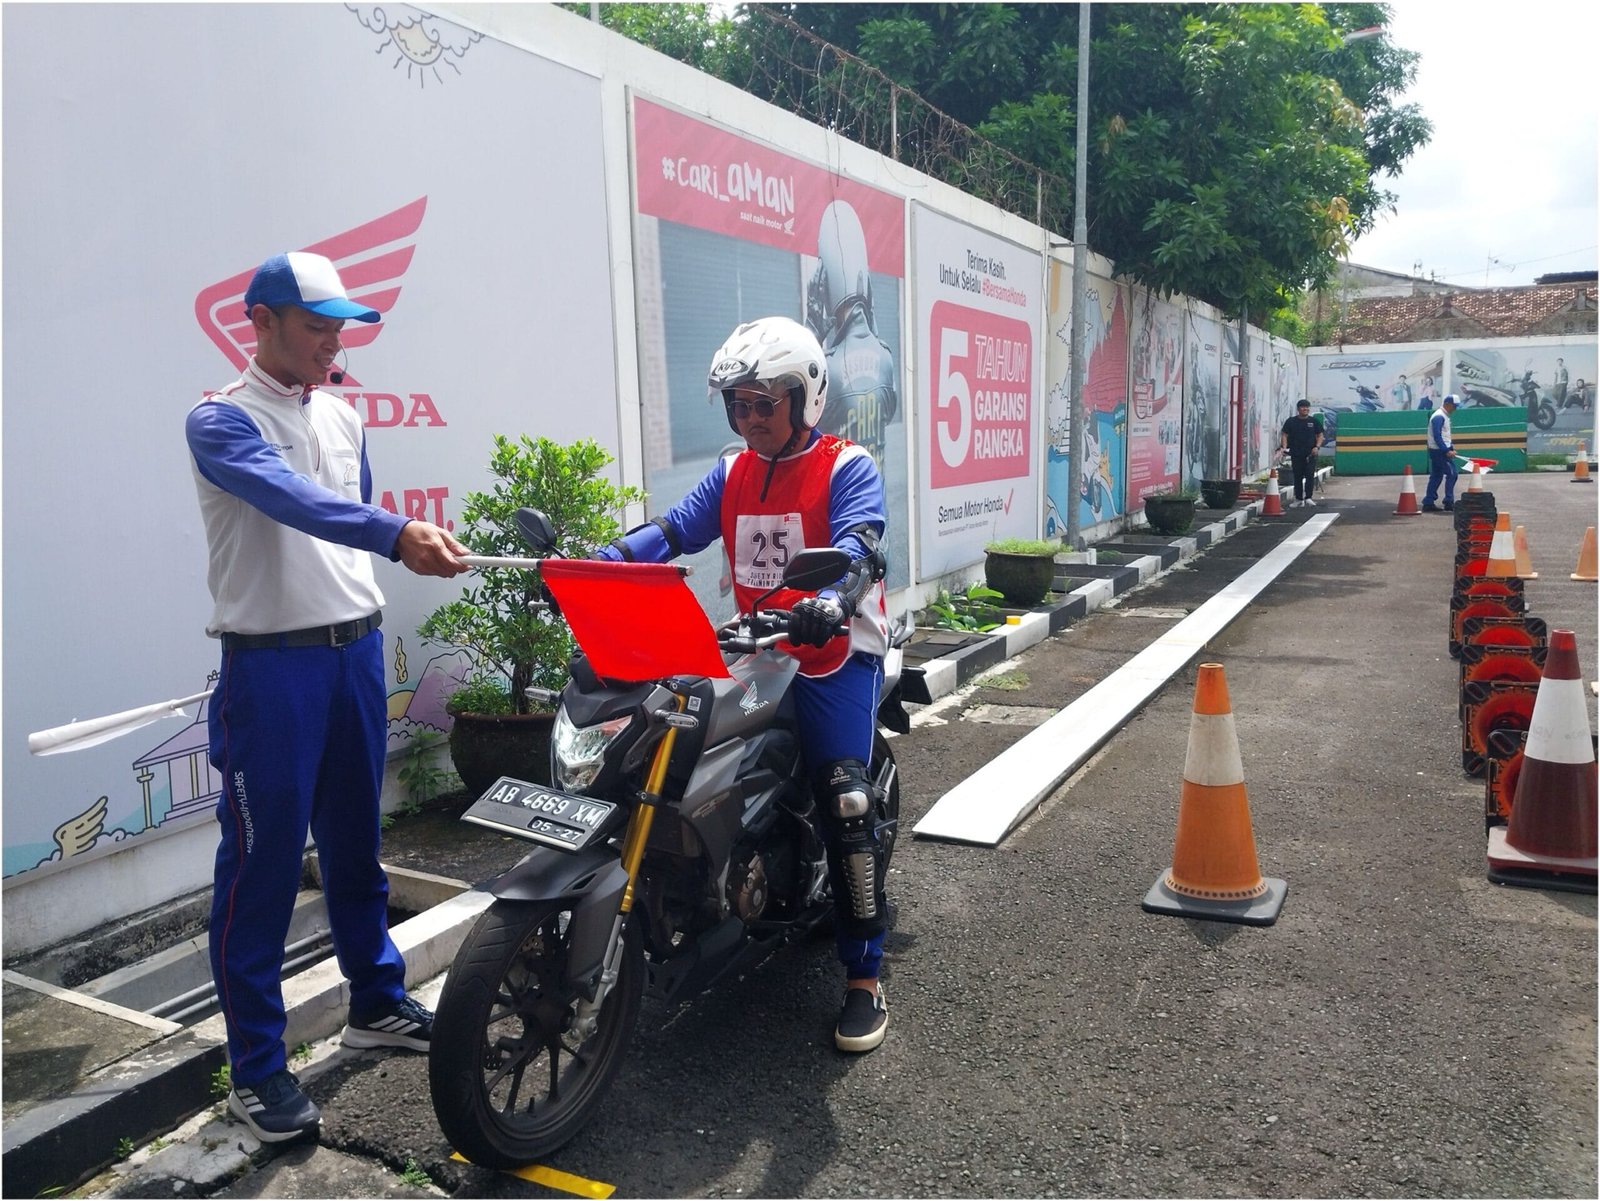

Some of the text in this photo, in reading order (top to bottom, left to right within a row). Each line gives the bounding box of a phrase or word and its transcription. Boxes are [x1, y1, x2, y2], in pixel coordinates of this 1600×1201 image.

[752, 215, 765, 225] naik
[765, 219, 782, 231] motor
[966, 248, 988, 273] Terima
[939, 263, 960, 289] Untuk
[961, 270, 981, 294] Selalu
[975, 334, 1027, 383] TAHUN
[937, 327, 971, 468] 5
[974, 390, 1026, 421] GARANSI
[974, 428, 1024, 460] RANGKA
[938, 495, 1004, 524] Semua Motor Honda
[751, 530, 789, 569] 25
[744, 700, 769, 716] HONDA
[491, 785, 604, 827] AB 4669 XM
